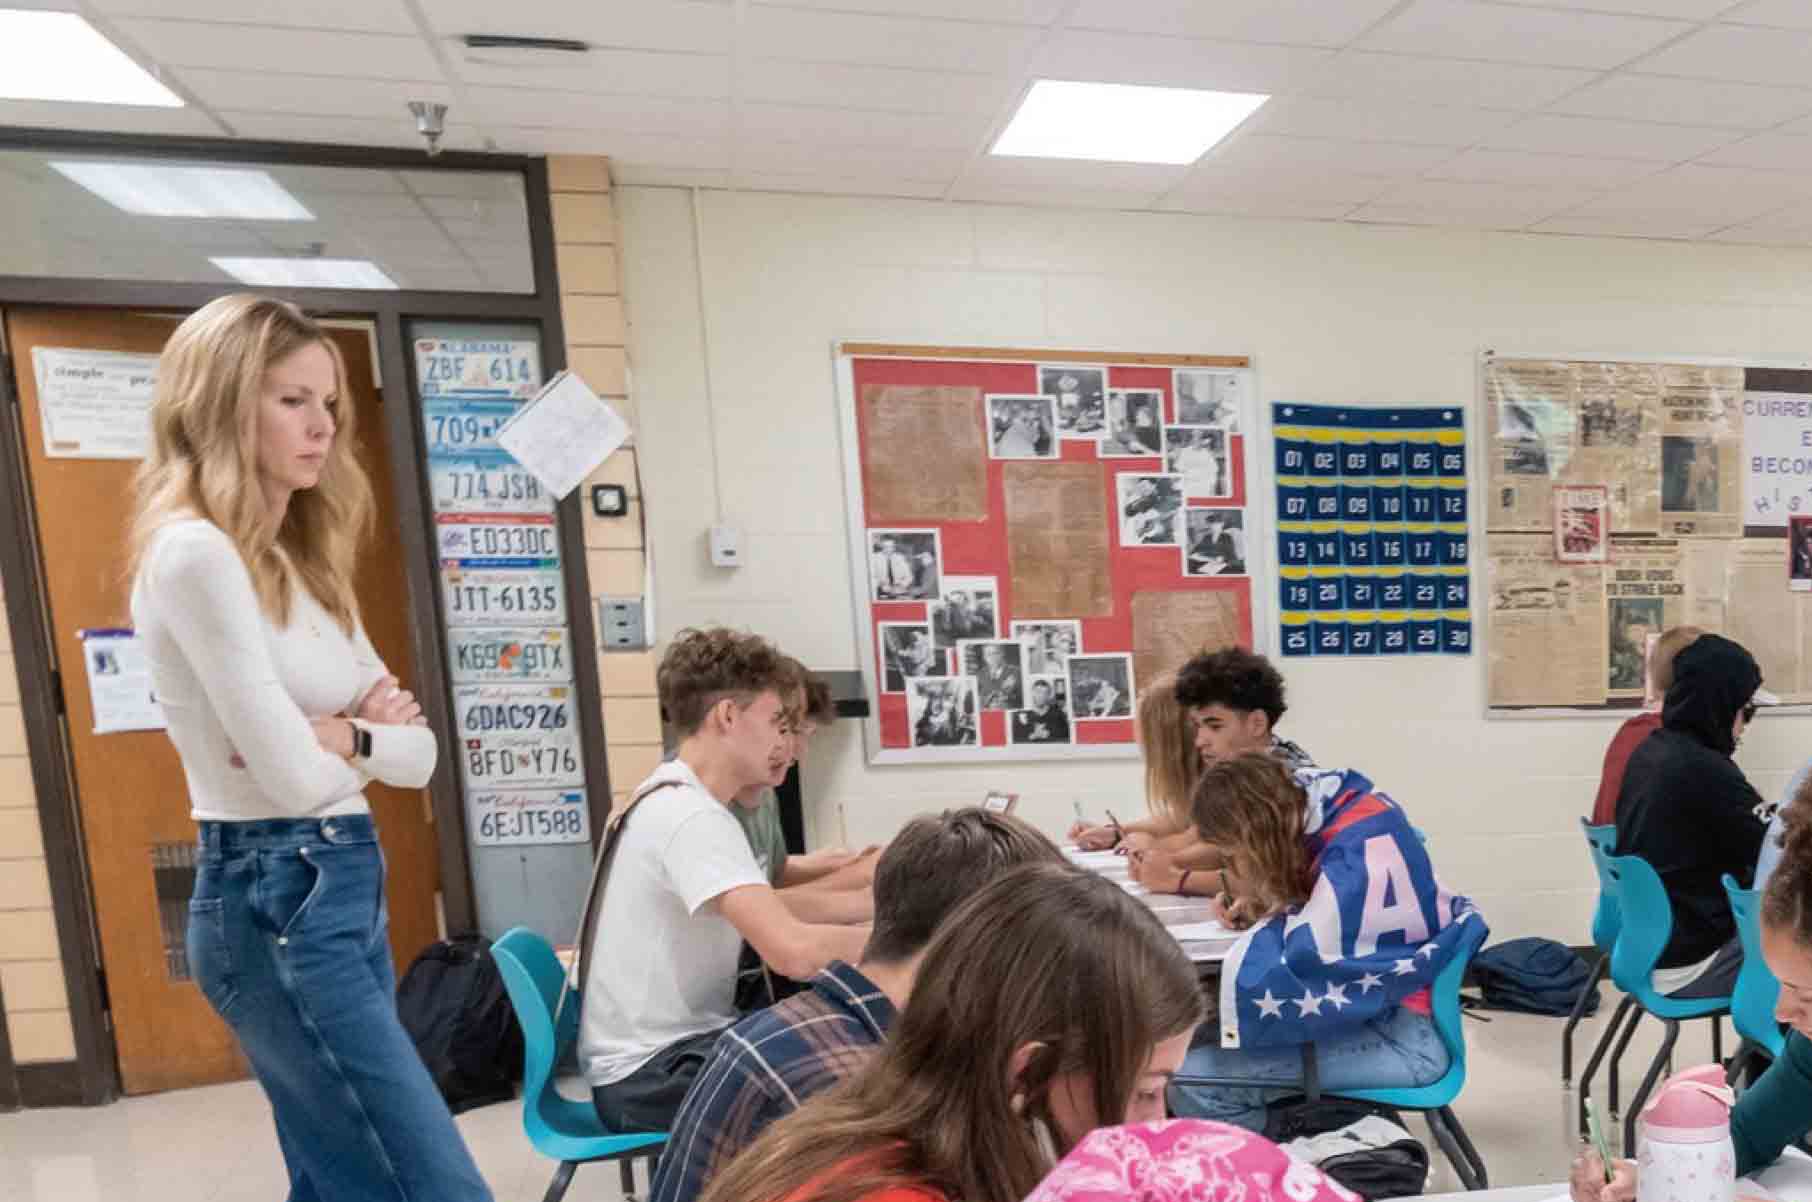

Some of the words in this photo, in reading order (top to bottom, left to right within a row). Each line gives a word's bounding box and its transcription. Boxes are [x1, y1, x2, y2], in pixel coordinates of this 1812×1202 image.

[426, 357, 464, 381] ZBF
[490, 357, 530, 382] 614
[432, 415, 480, 444] 709
[1285, 450, 1303, 469] 01
[1313, 452, 1334, 470] 02
[1347, 452, 1367, 470] 03
[1381, 452, 1400, 469] 04
[1413, 452, 1431, 469] 05
[1443, 453, 1462, 470] 06
[1287, 497, 1305, 514] 07
[1318, 496, 1337, 513] 08
[1348, 497, 1367, 513] 09
[1383, 497, 1400, 513] 10
[1413, 497, 1429, 513] 11
[1445, 497, 1462, 513] 12
[1288, 541, 1306, 559] 13
[1317, 541, 1335, 557] 14
[1350, 541, 1367, 557] 15
[1383, 541, 1400, 557] 16
[1415, 541, 1431, 557] 17
[453, 586, 557, 613] JTT-6135
[1290, 586, 1308, 603] 19
[1319, 584, 1337, 601] 20
[1354, 585, 1371, 601] 21
[1383, 585, 1402, 601] 22
[1416, 585, 1435, 600] 23
[1447, 585, 1465, 600] 24
[1287, 631, 1306, 648] 25
[1322, 631, 1340, 647] 26
[1353, 631, 1371, 647] 27
[1418, 629, 1436, 645] 29
[465, 703, 568, 731] 6DAC926
[480, 809, 583, 837] 6EJT588
